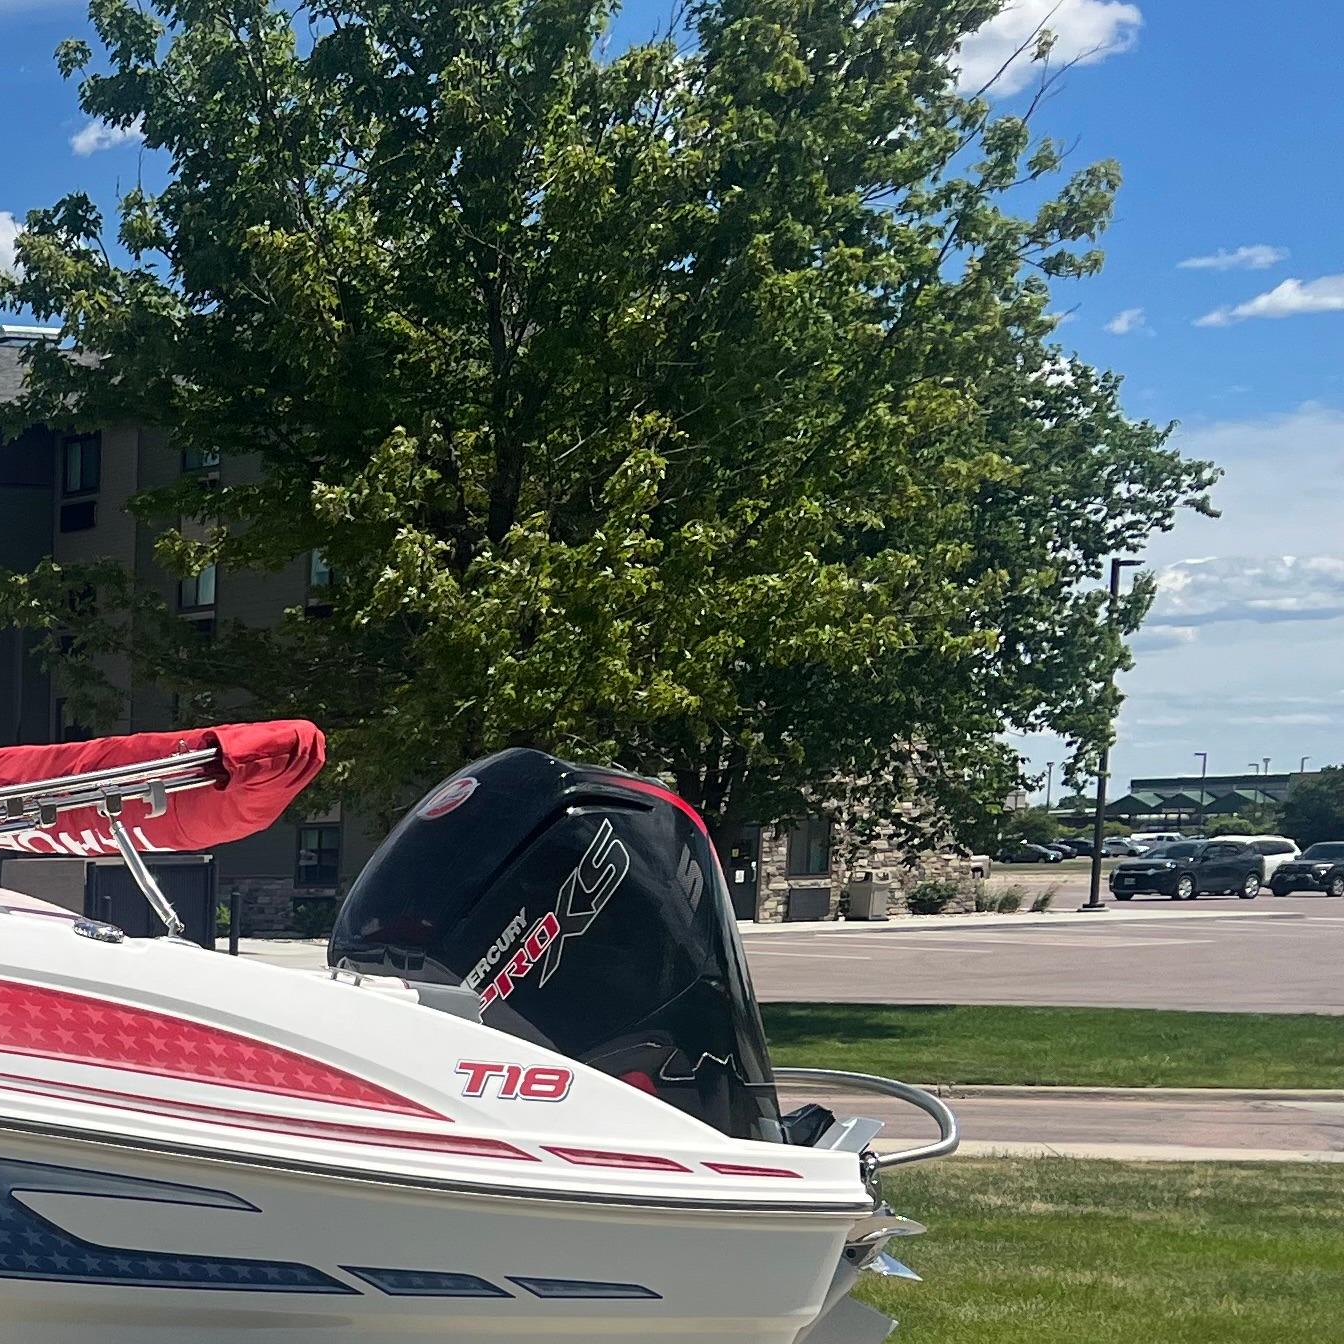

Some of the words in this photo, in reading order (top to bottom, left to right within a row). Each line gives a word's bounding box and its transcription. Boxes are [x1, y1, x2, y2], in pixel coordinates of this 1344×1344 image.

[520, 817, 631, 989] XS
[460, 906, 528, 991] ERCURY
[454, 1059, 574, 1103] T18
